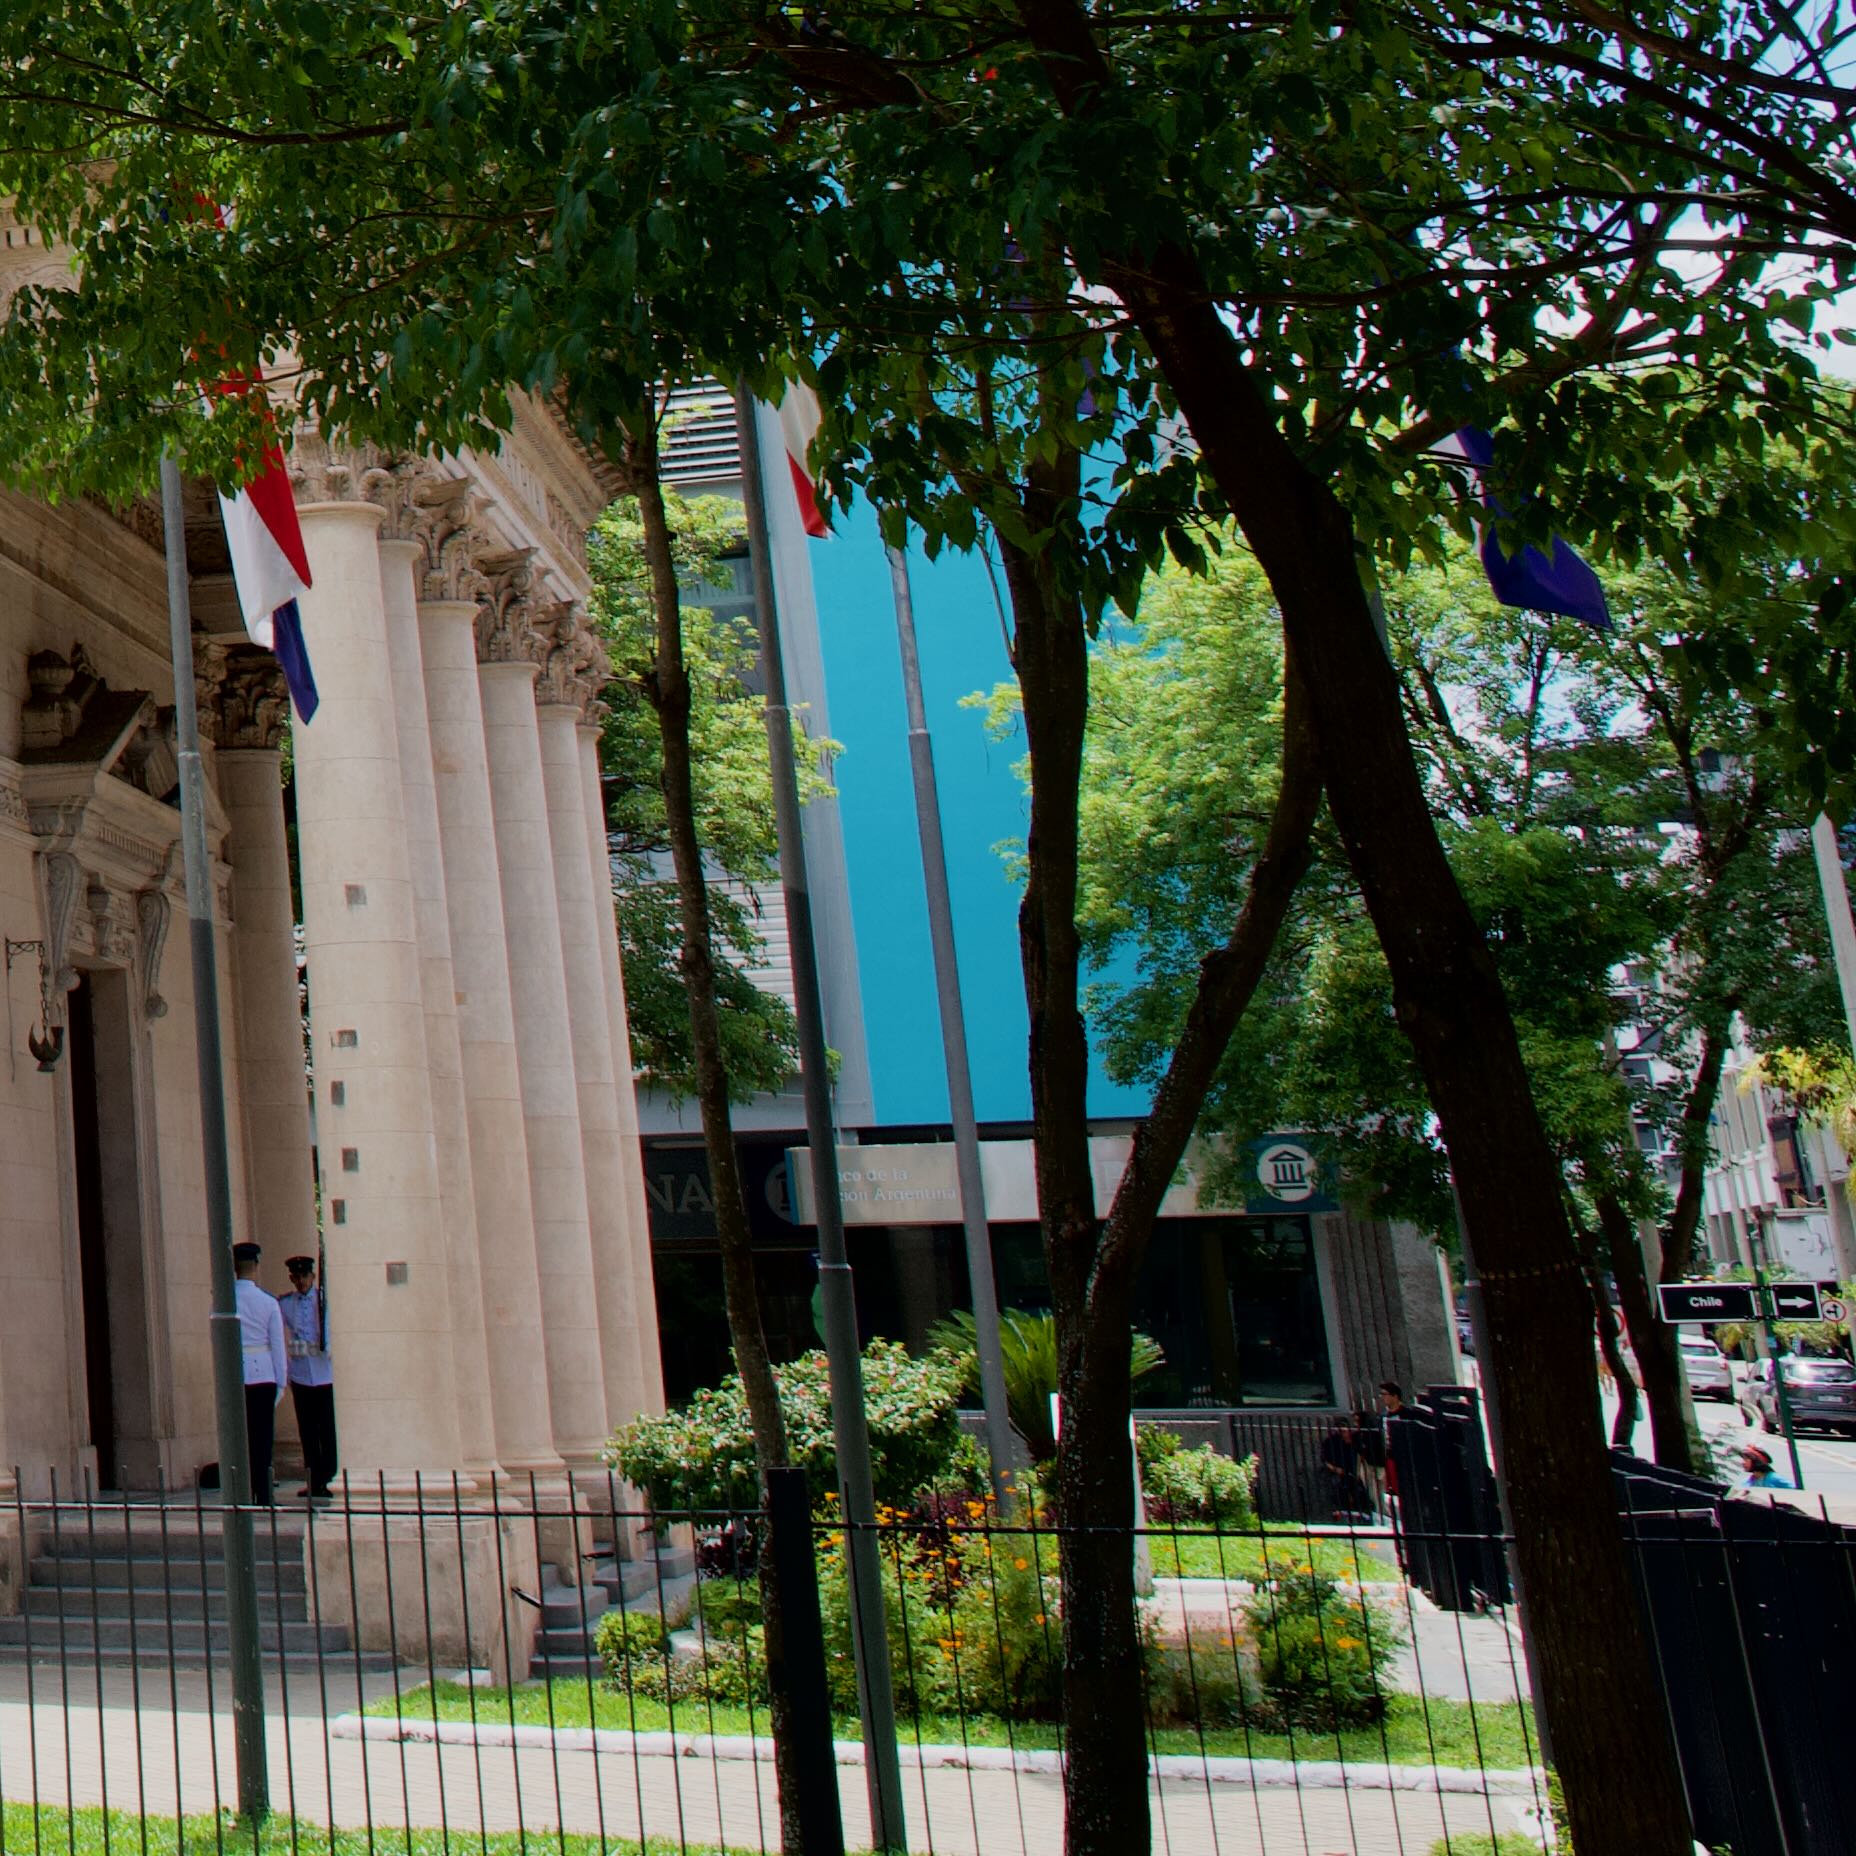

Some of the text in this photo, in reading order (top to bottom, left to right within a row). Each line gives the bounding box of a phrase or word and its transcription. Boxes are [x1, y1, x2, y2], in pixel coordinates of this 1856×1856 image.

[866, 1168, 888, 1181] de
[893, 1167, 909, 1181] la
[874, 1187, 957, 1202] Argentina
[1689, 1296, 1723, 1308] Chile
